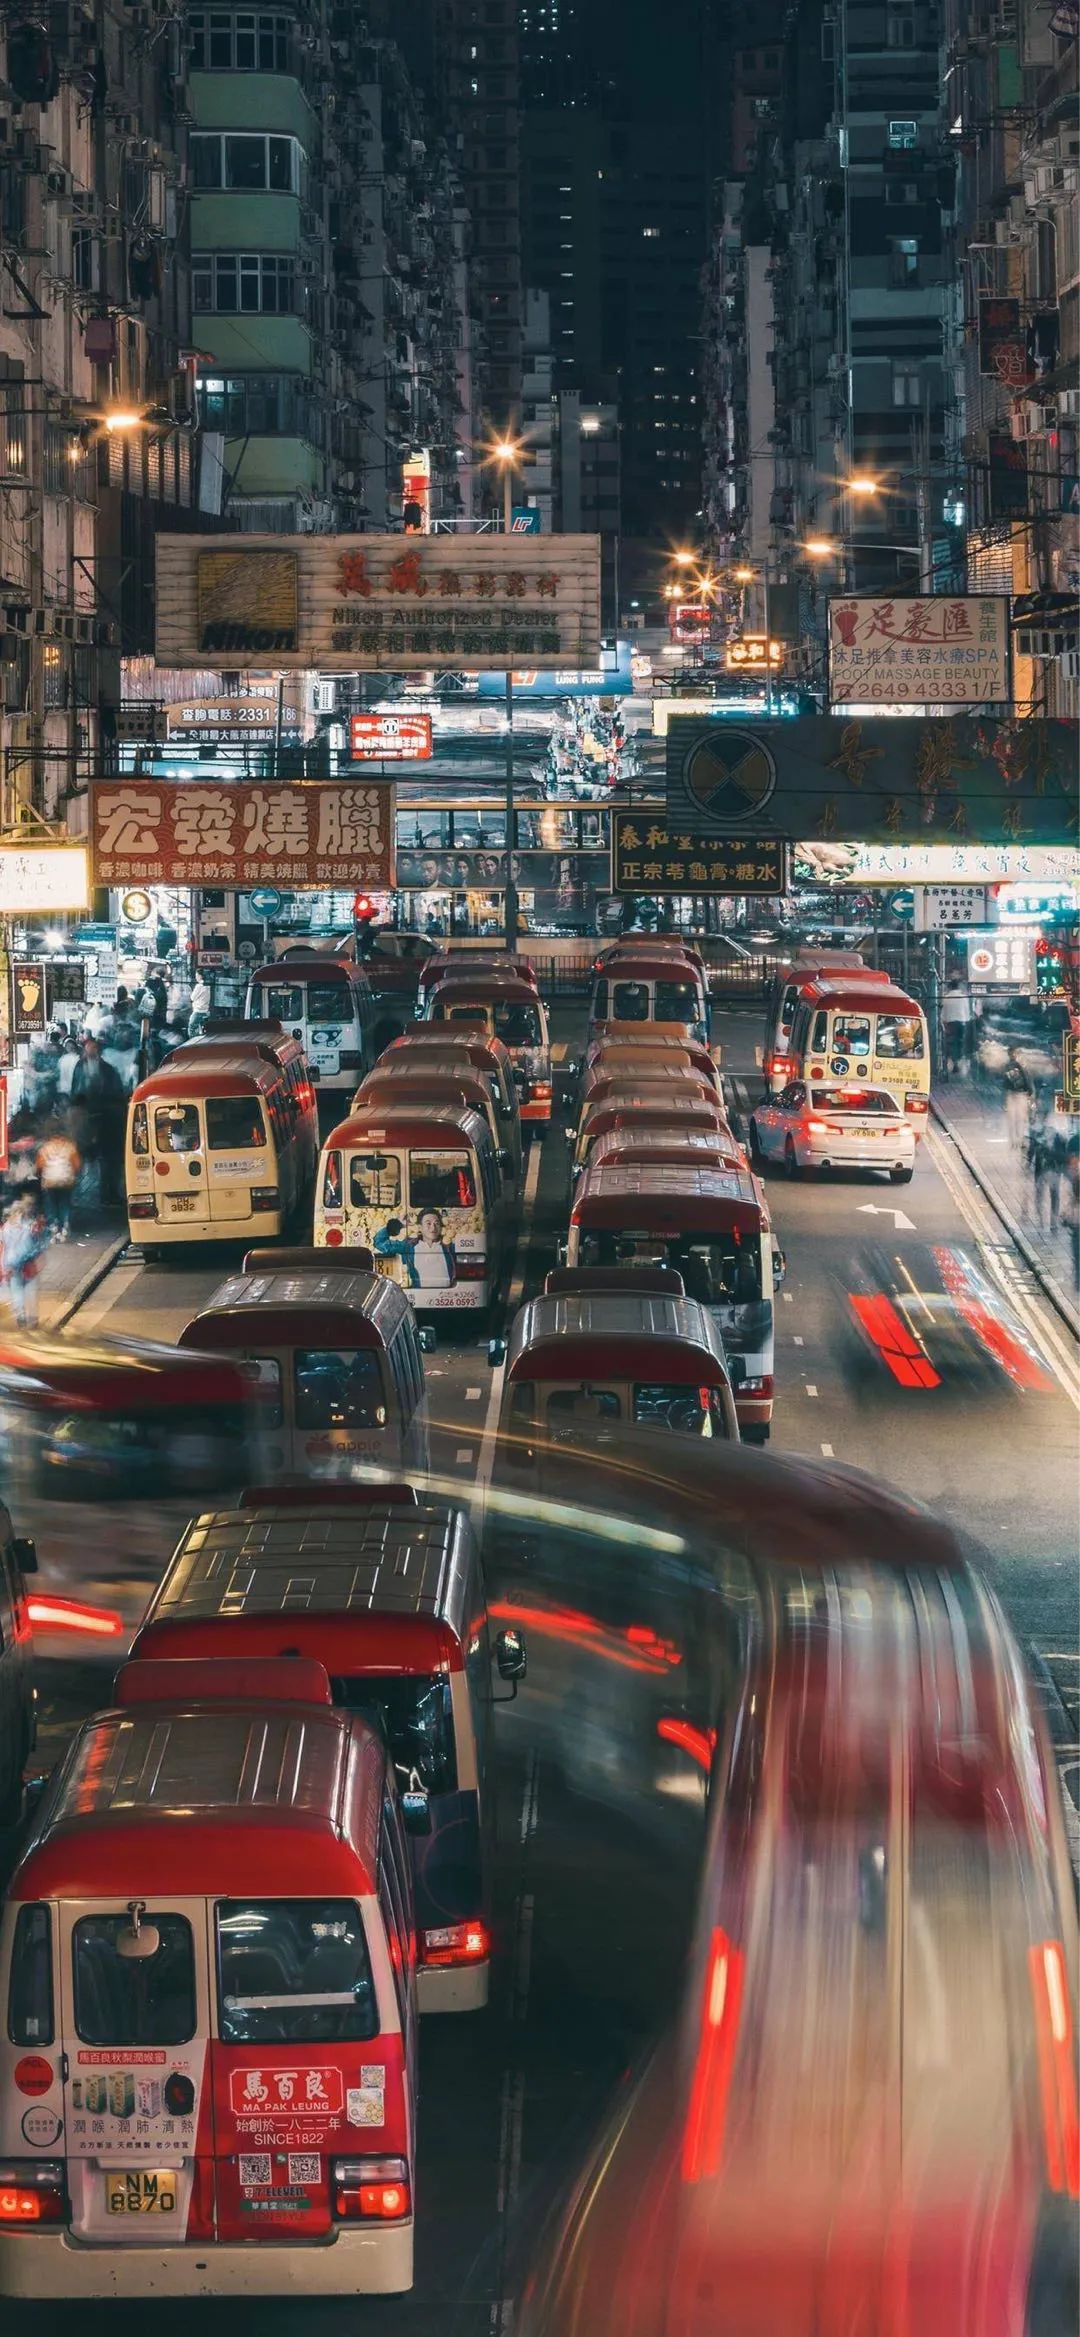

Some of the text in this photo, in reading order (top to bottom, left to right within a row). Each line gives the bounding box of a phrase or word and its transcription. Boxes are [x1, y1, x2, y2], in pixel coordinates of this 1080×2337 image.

[332, 608, 384, 625] Nikon
[391, 607, 493, 626] Authorized
[863, 601, 975, 644] 足豪匯
[201, 619, 297, 651] Nikon
[832, 668, 1000, 681] FOOT MASSAGE BEAUTY
[858, 681, 1002, 698] 2649 4333 1/F
[97, 789, 385, 856] 宏發燒臘
[98, 862, 164, 879] 香濃咖啡
[171, 862, 236, 879] 香濃奶茶
[460, 1239, 475, 1248] SGS
[242, 2101, 330, 2112] MA PAK LEUNG
[236, 2116, 342, 2133] 始創於一八二二年
[254, 2132, 325, 2146] SINCE1822
[126, 2173, 158, 2193] NM
[110, 2192, 175, 2212] 8870
